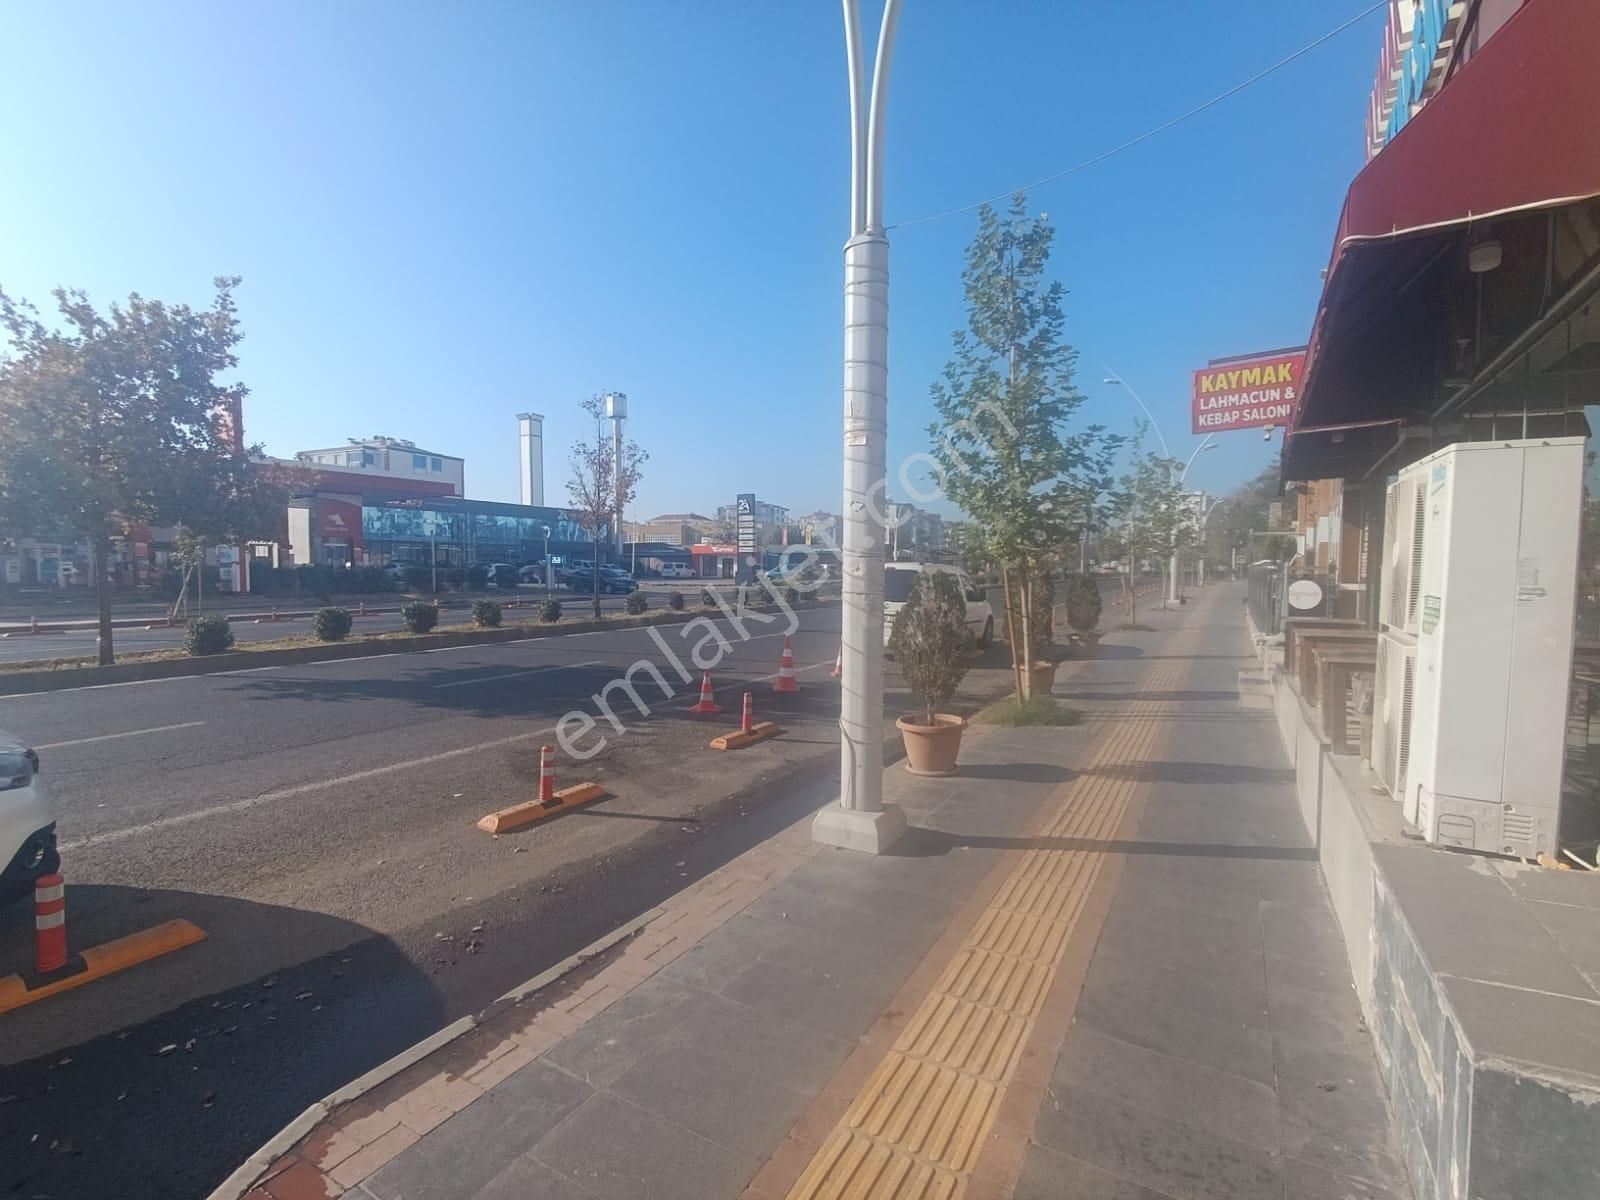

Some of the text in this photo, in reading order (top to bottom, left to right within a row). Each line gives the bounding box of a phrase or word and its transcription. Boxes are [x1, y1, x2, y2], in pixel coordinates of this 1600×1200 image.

[1201, 362, 1293, 393] KAYMAK
[1199, 386, 1296, 411] LAHMACUN &
[1198, 410, 1240, 427] KEBAP
